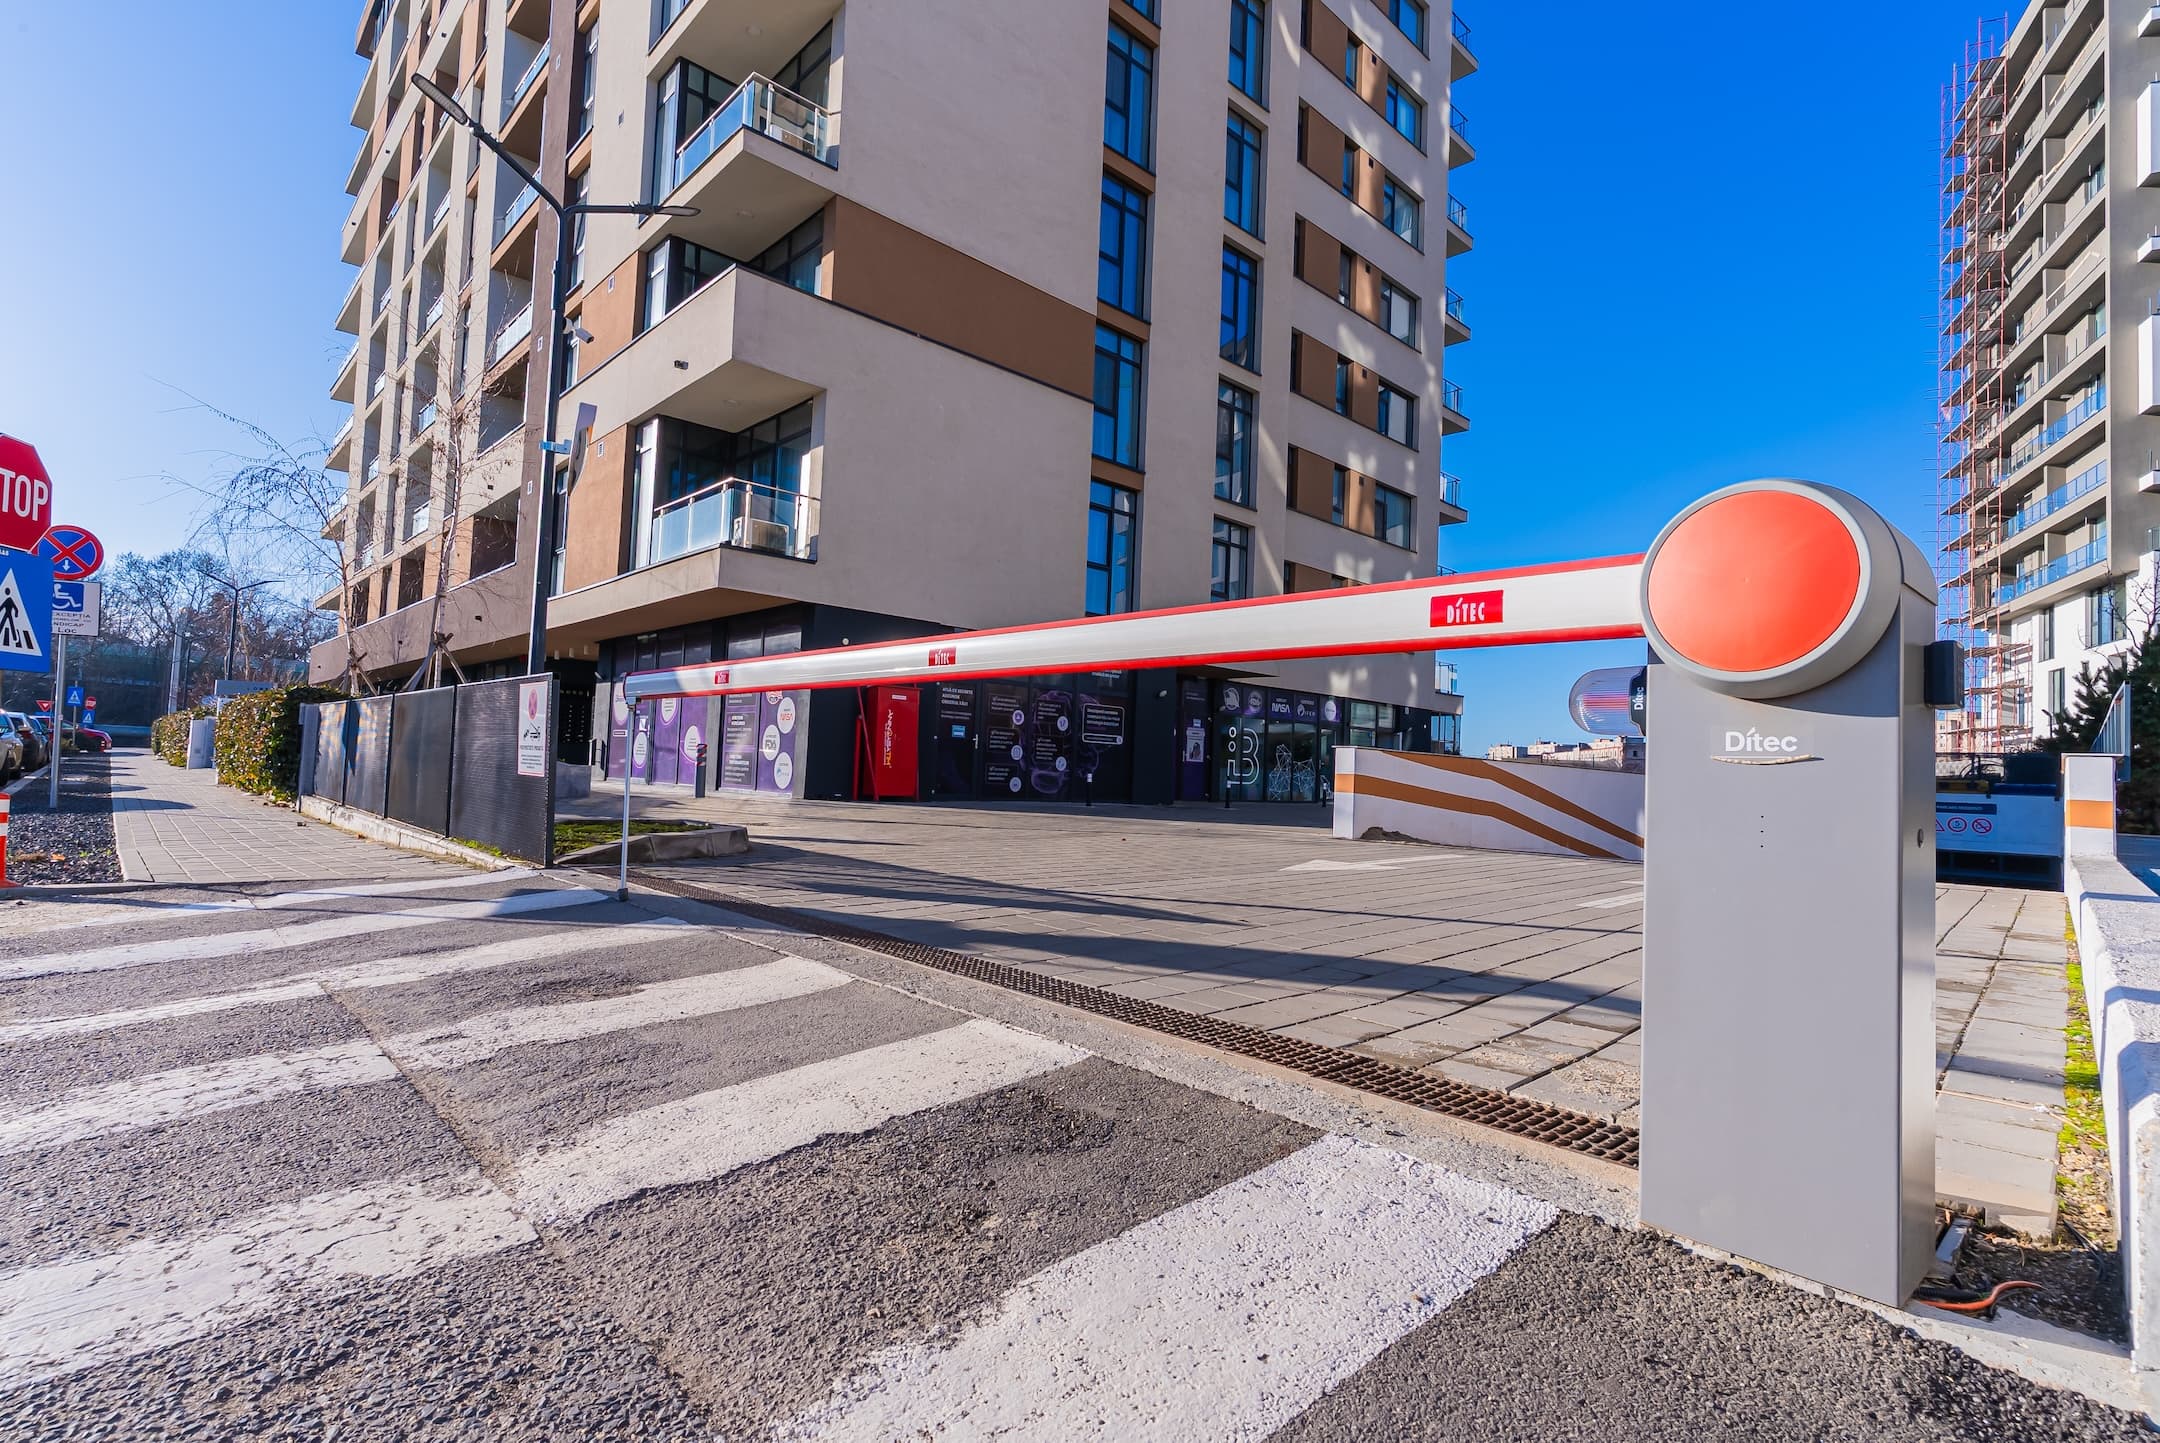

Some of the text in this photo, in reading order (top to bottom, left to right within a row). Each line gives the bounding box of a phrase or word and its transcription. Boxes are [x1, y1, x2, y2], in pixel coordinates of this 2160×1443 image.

[0, 467, 48, 521] TOP
[1271, 702, 1291, 714] NASA
[1724, 727, 1799, 752] Dítec
